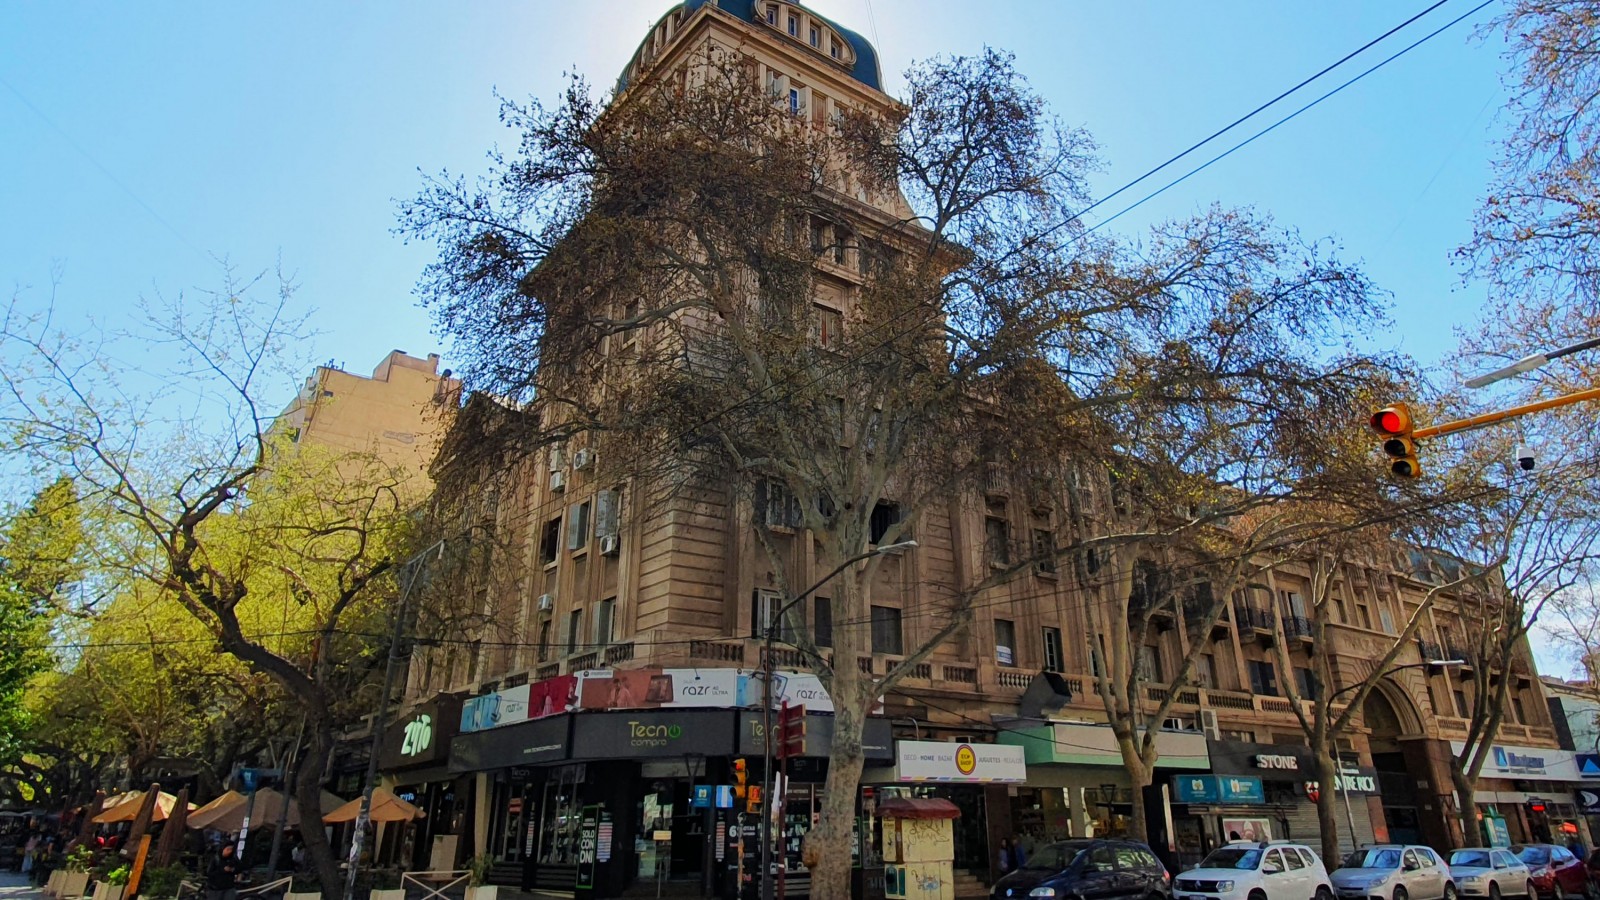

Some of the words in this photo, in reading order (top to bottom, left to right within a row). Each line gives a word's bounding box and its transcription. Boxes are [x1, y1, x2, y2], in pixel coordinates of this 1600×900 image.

[682, 685, 711, 696] razr
[796, 689, 818, 699] razr
[631, 739, 667, 747] compro
[1256, 754, 1298, 770] STONE
[582, 829, 595, 839] SOLO
[581, 839, 594, 850] CON
[580, 850, 593, 864] DNI
